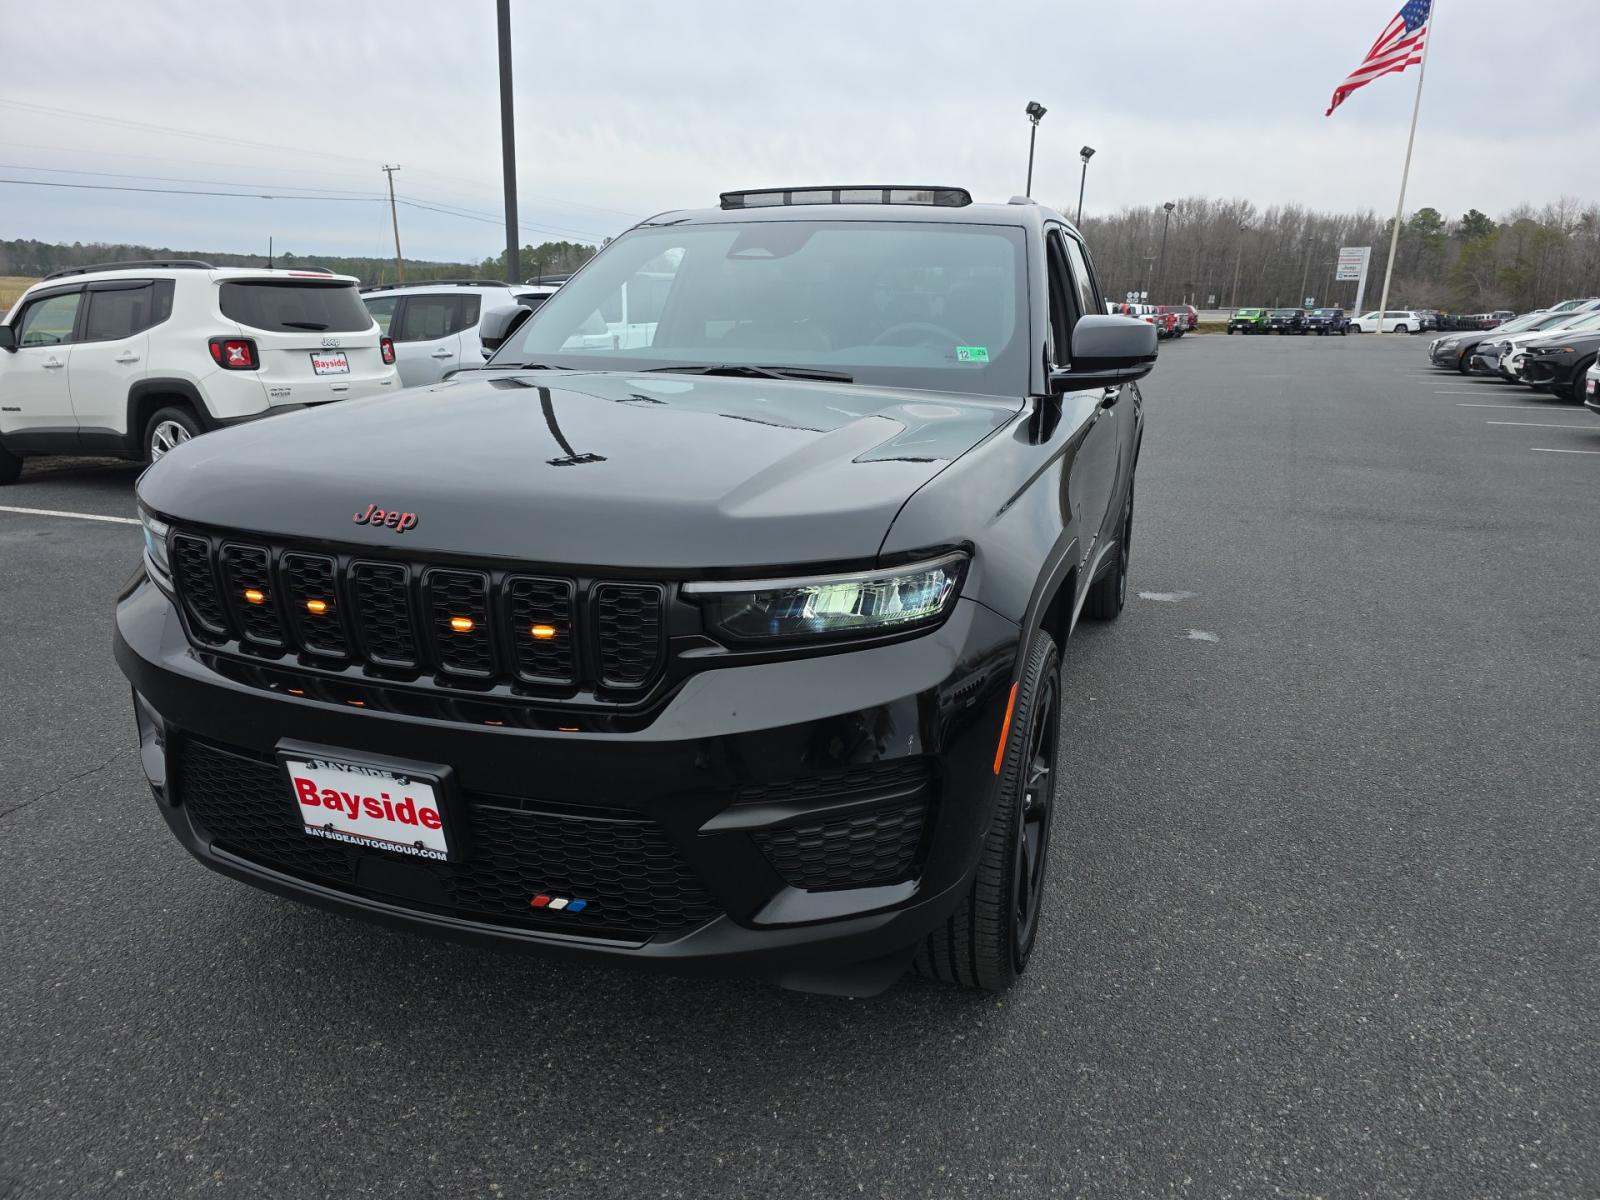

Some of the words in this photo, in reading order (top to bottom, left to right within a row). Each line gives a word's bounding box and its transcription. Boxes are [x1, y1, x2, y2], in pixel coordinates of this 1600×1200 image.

[314, 359, 346, 369] Bayside
[960, 350, 970, 360] 12
[352, 504, 418, 533] Jeep
[313, 760, 393, 779] BAYSIDE
[294, 777, 442, 829] Bayside
[304, 826, 448, 862] BAYSIDEAUTOGROUP.COM
